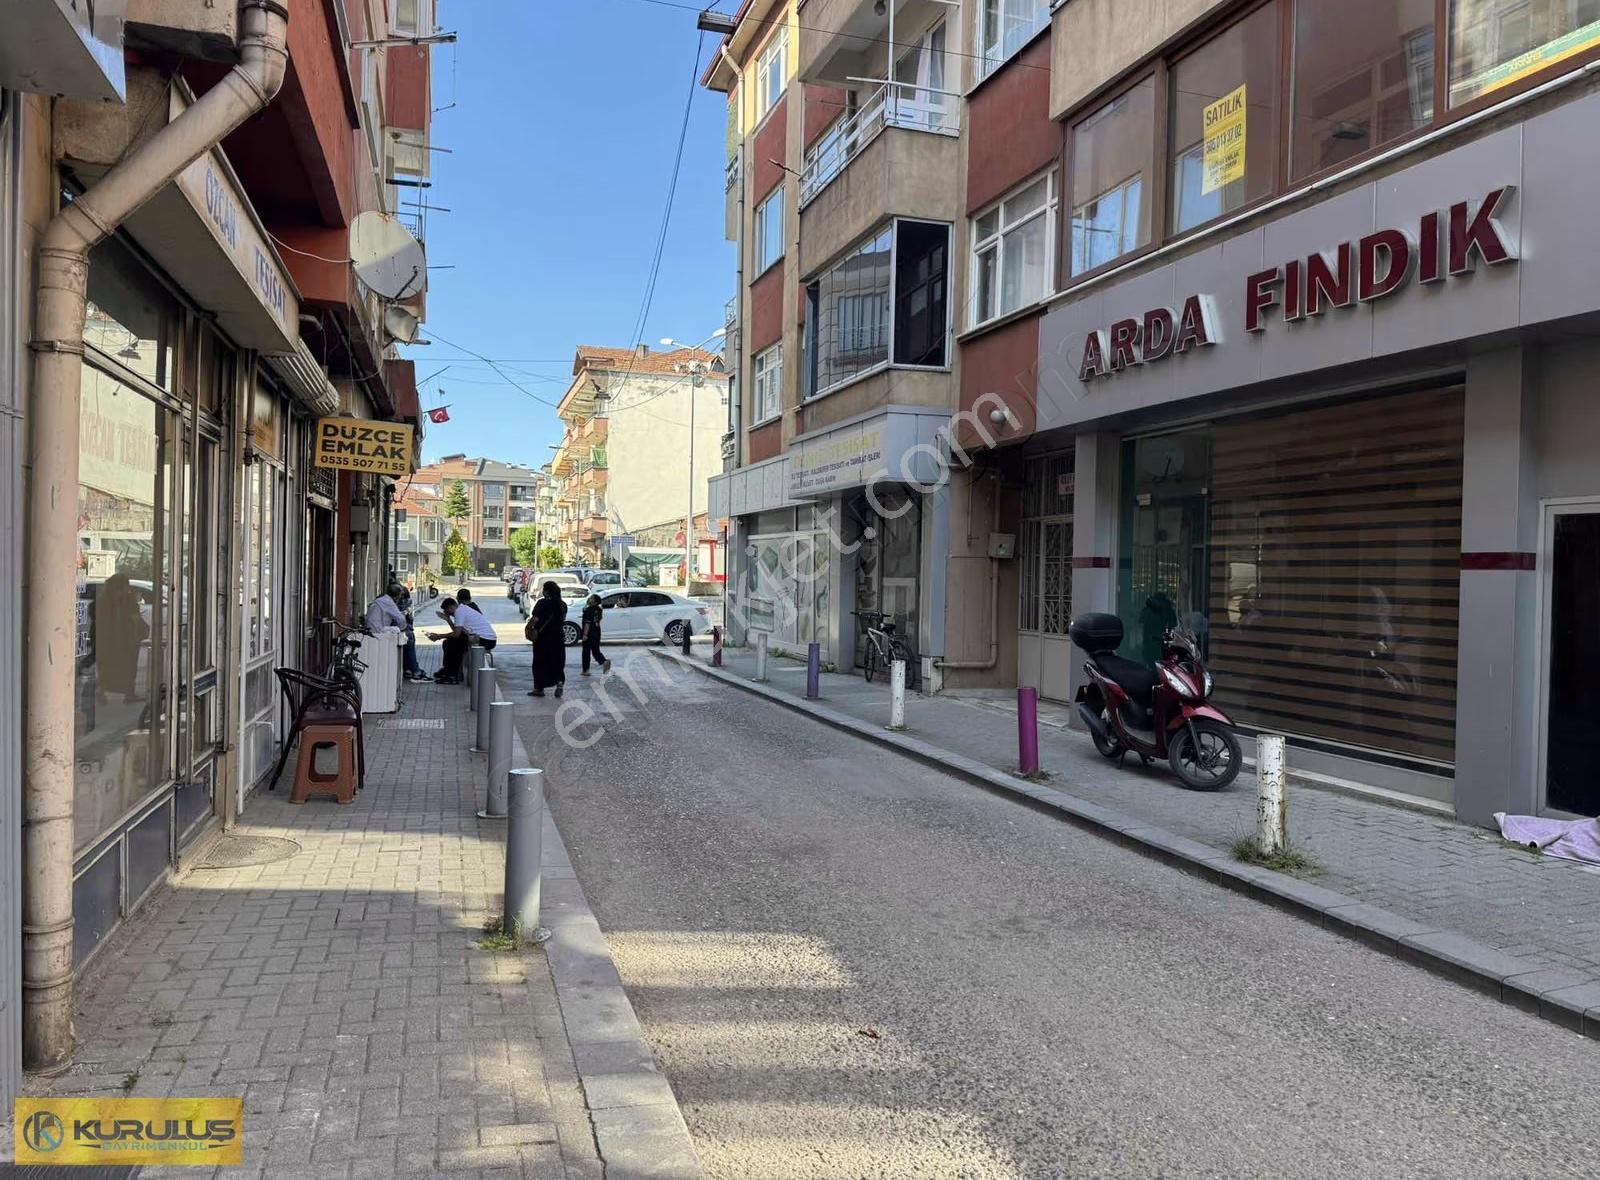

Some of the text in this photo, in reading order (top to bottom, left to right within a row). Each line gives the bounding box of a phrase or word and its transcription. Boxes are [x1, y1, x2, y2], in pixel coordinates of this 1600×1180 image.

[1206, 92, 1242, 126] SATILIK
[255, 245, 286, 322] TESİSAT
[1078, 185, 1519, 381] ARDA FINDIK
[320, 455, 406, 472] 0535 507 71 55
[321, 439, 405, 460] EMLAK
